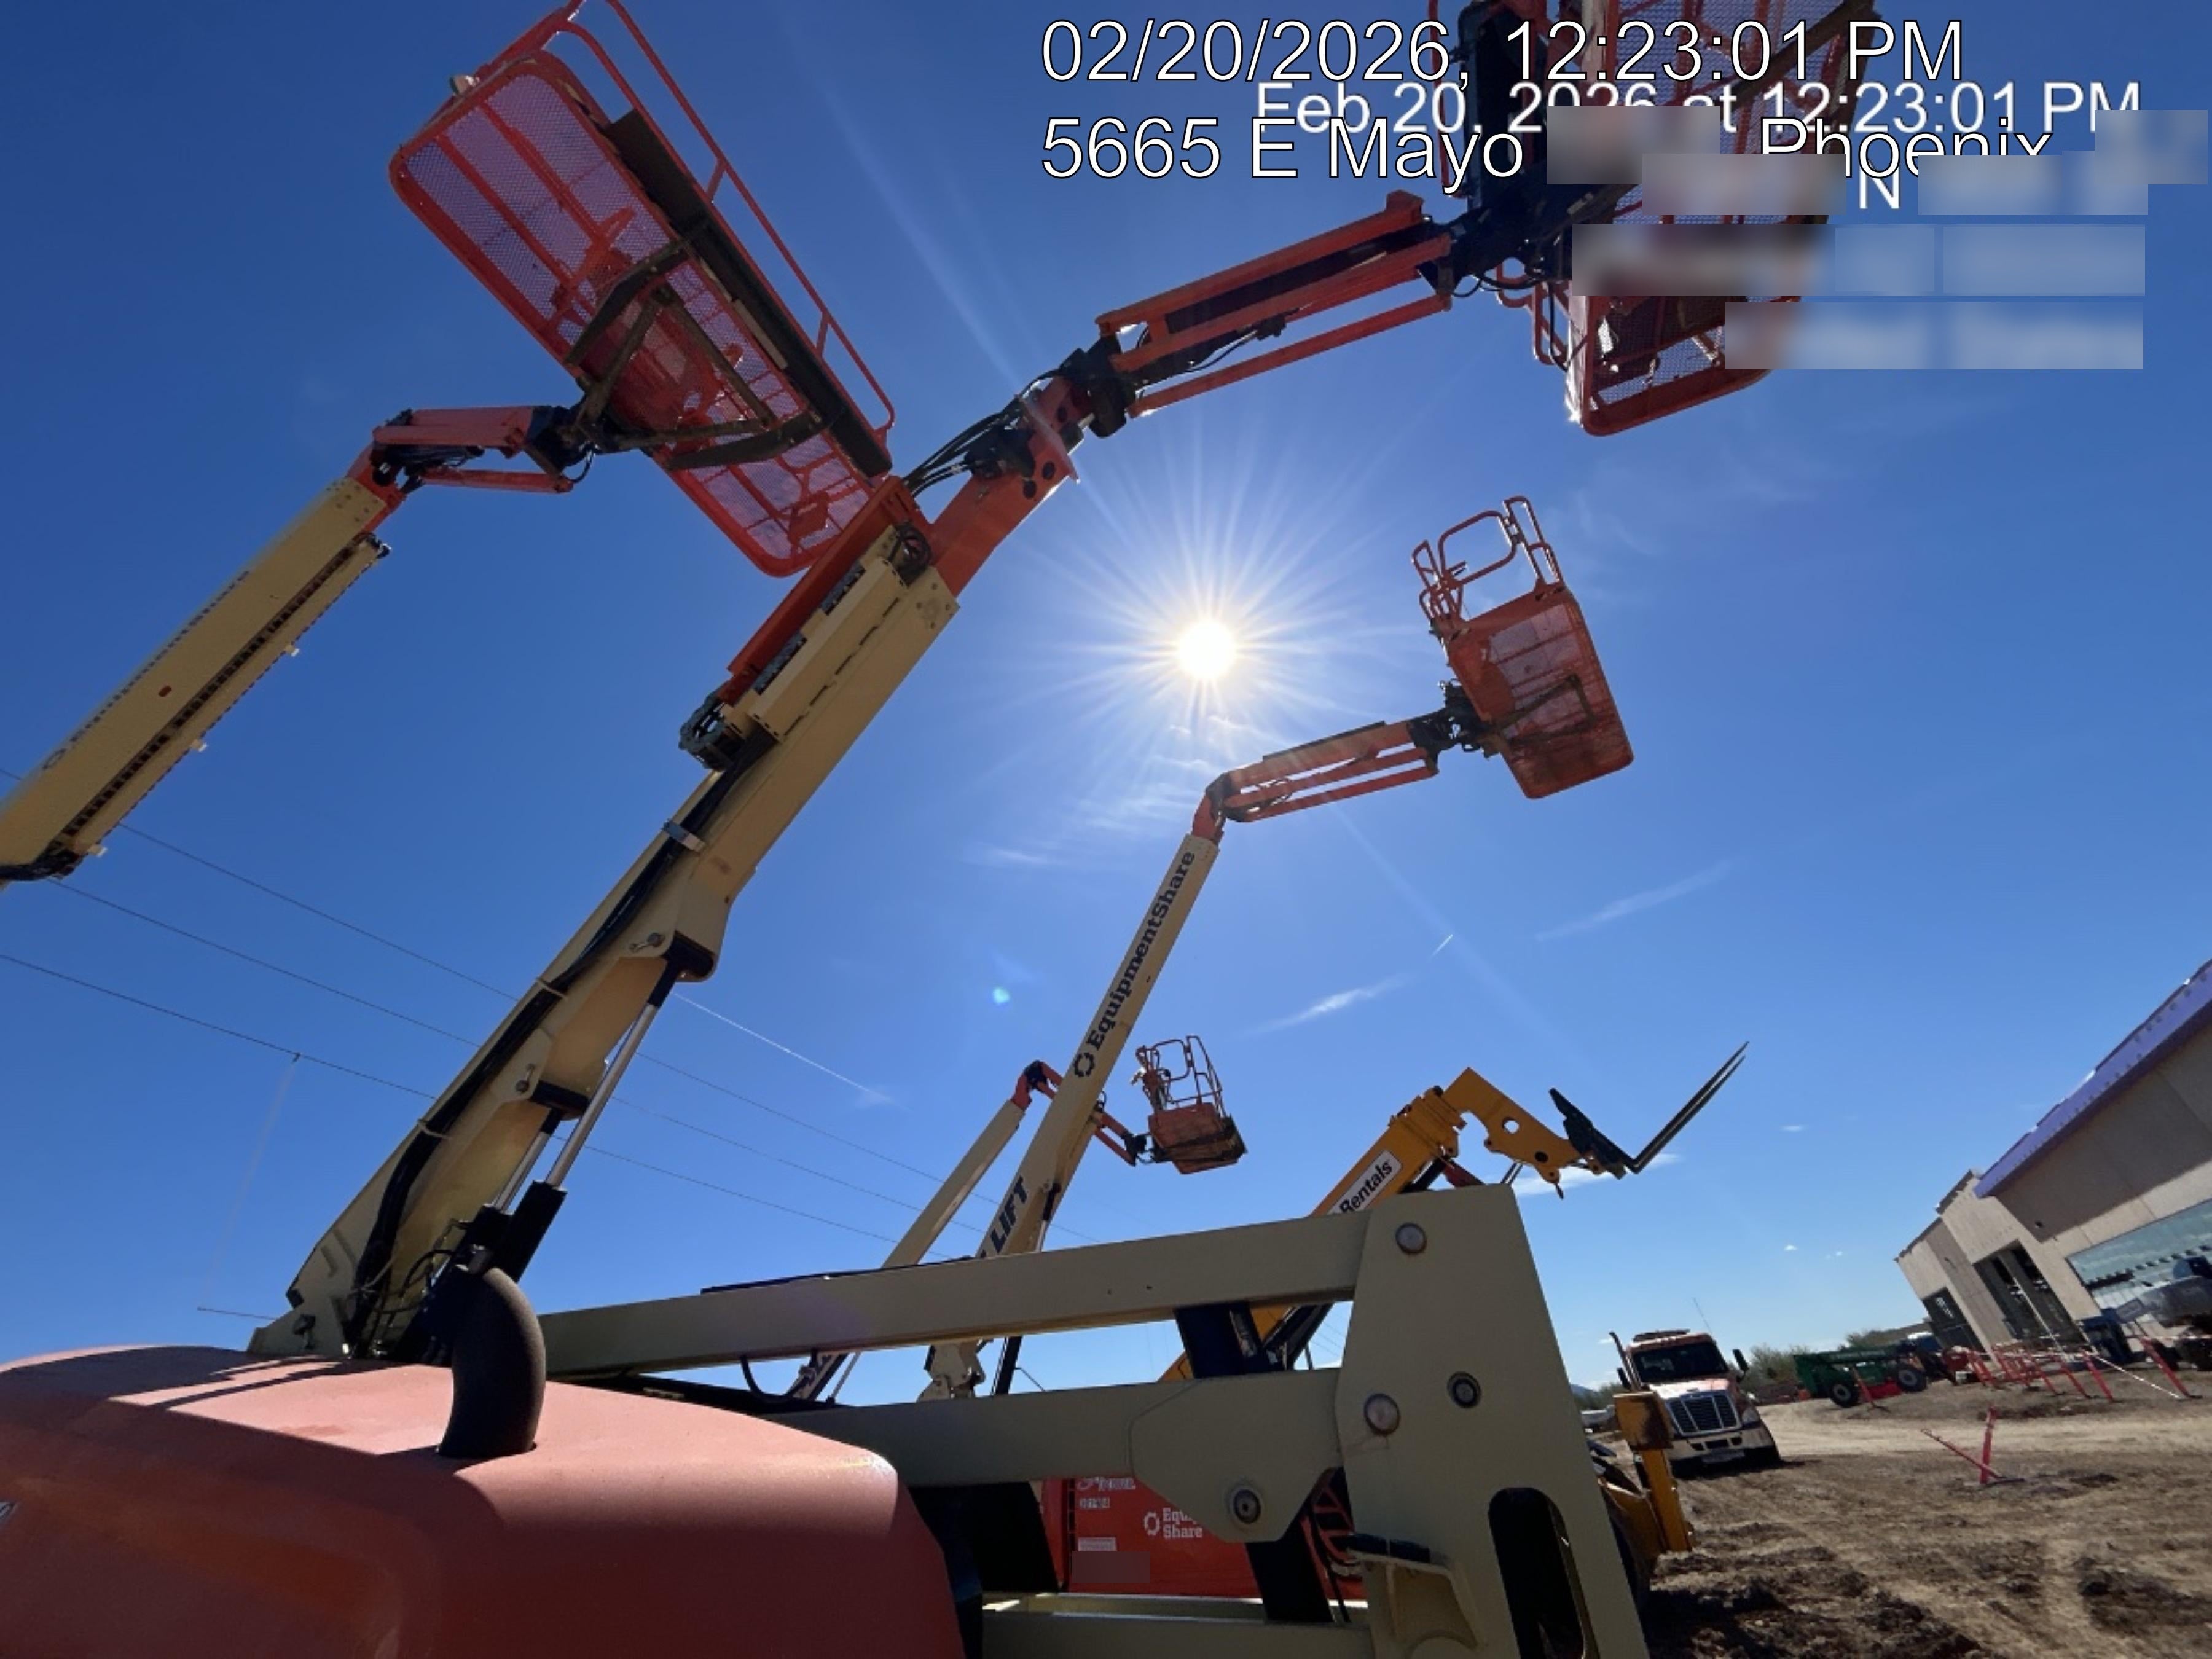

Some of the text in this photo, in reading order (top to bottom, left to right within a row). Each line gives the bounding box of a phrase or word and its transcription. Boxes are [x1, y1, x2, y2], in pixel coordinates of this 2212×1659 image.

[1086, 851, 1195, 1051] EquipmentShare
[989, 1175, 1027, 1255] LIFT
[1339, 1161, 1392, 1213] Rentals
[1163, 1524, 1203, 1539] Share
